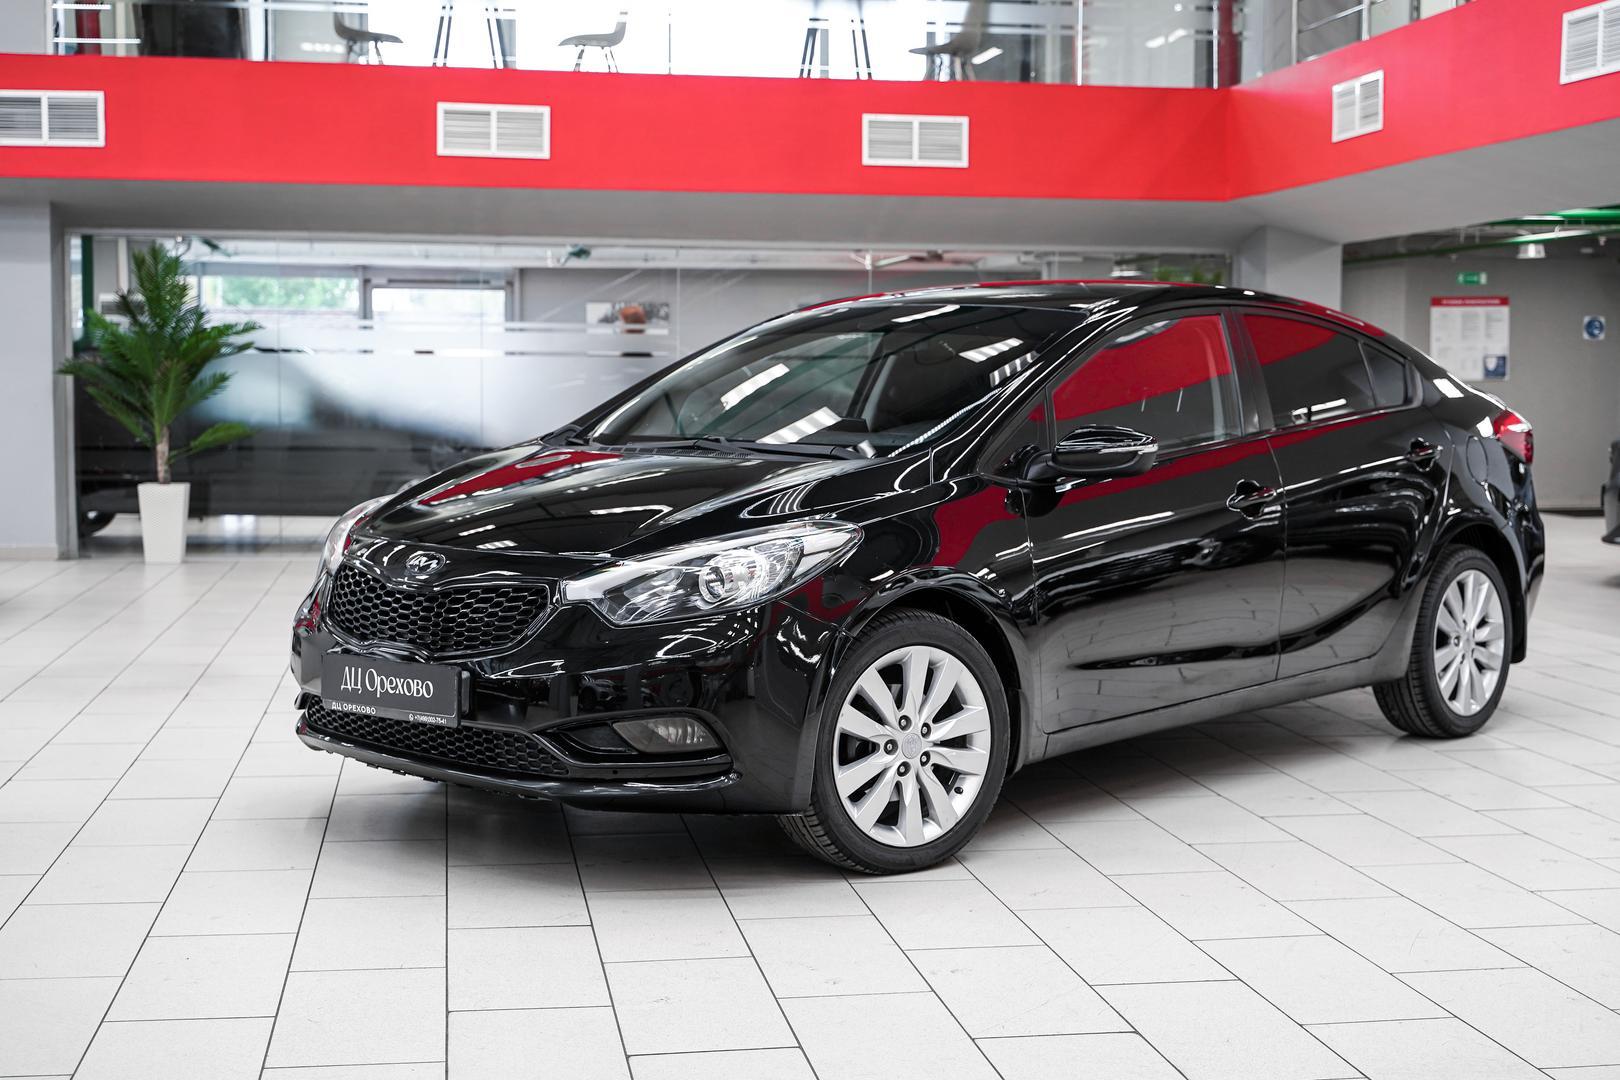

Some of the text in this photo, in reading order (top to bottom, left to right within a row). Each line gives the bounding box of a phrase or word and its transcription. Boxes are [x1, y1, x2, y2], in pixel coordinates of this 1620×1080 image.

[340, 665, 434, 698] ДЦ Орехово
[331, 702, 377, 715] ДЦ ОРЕХОВО
